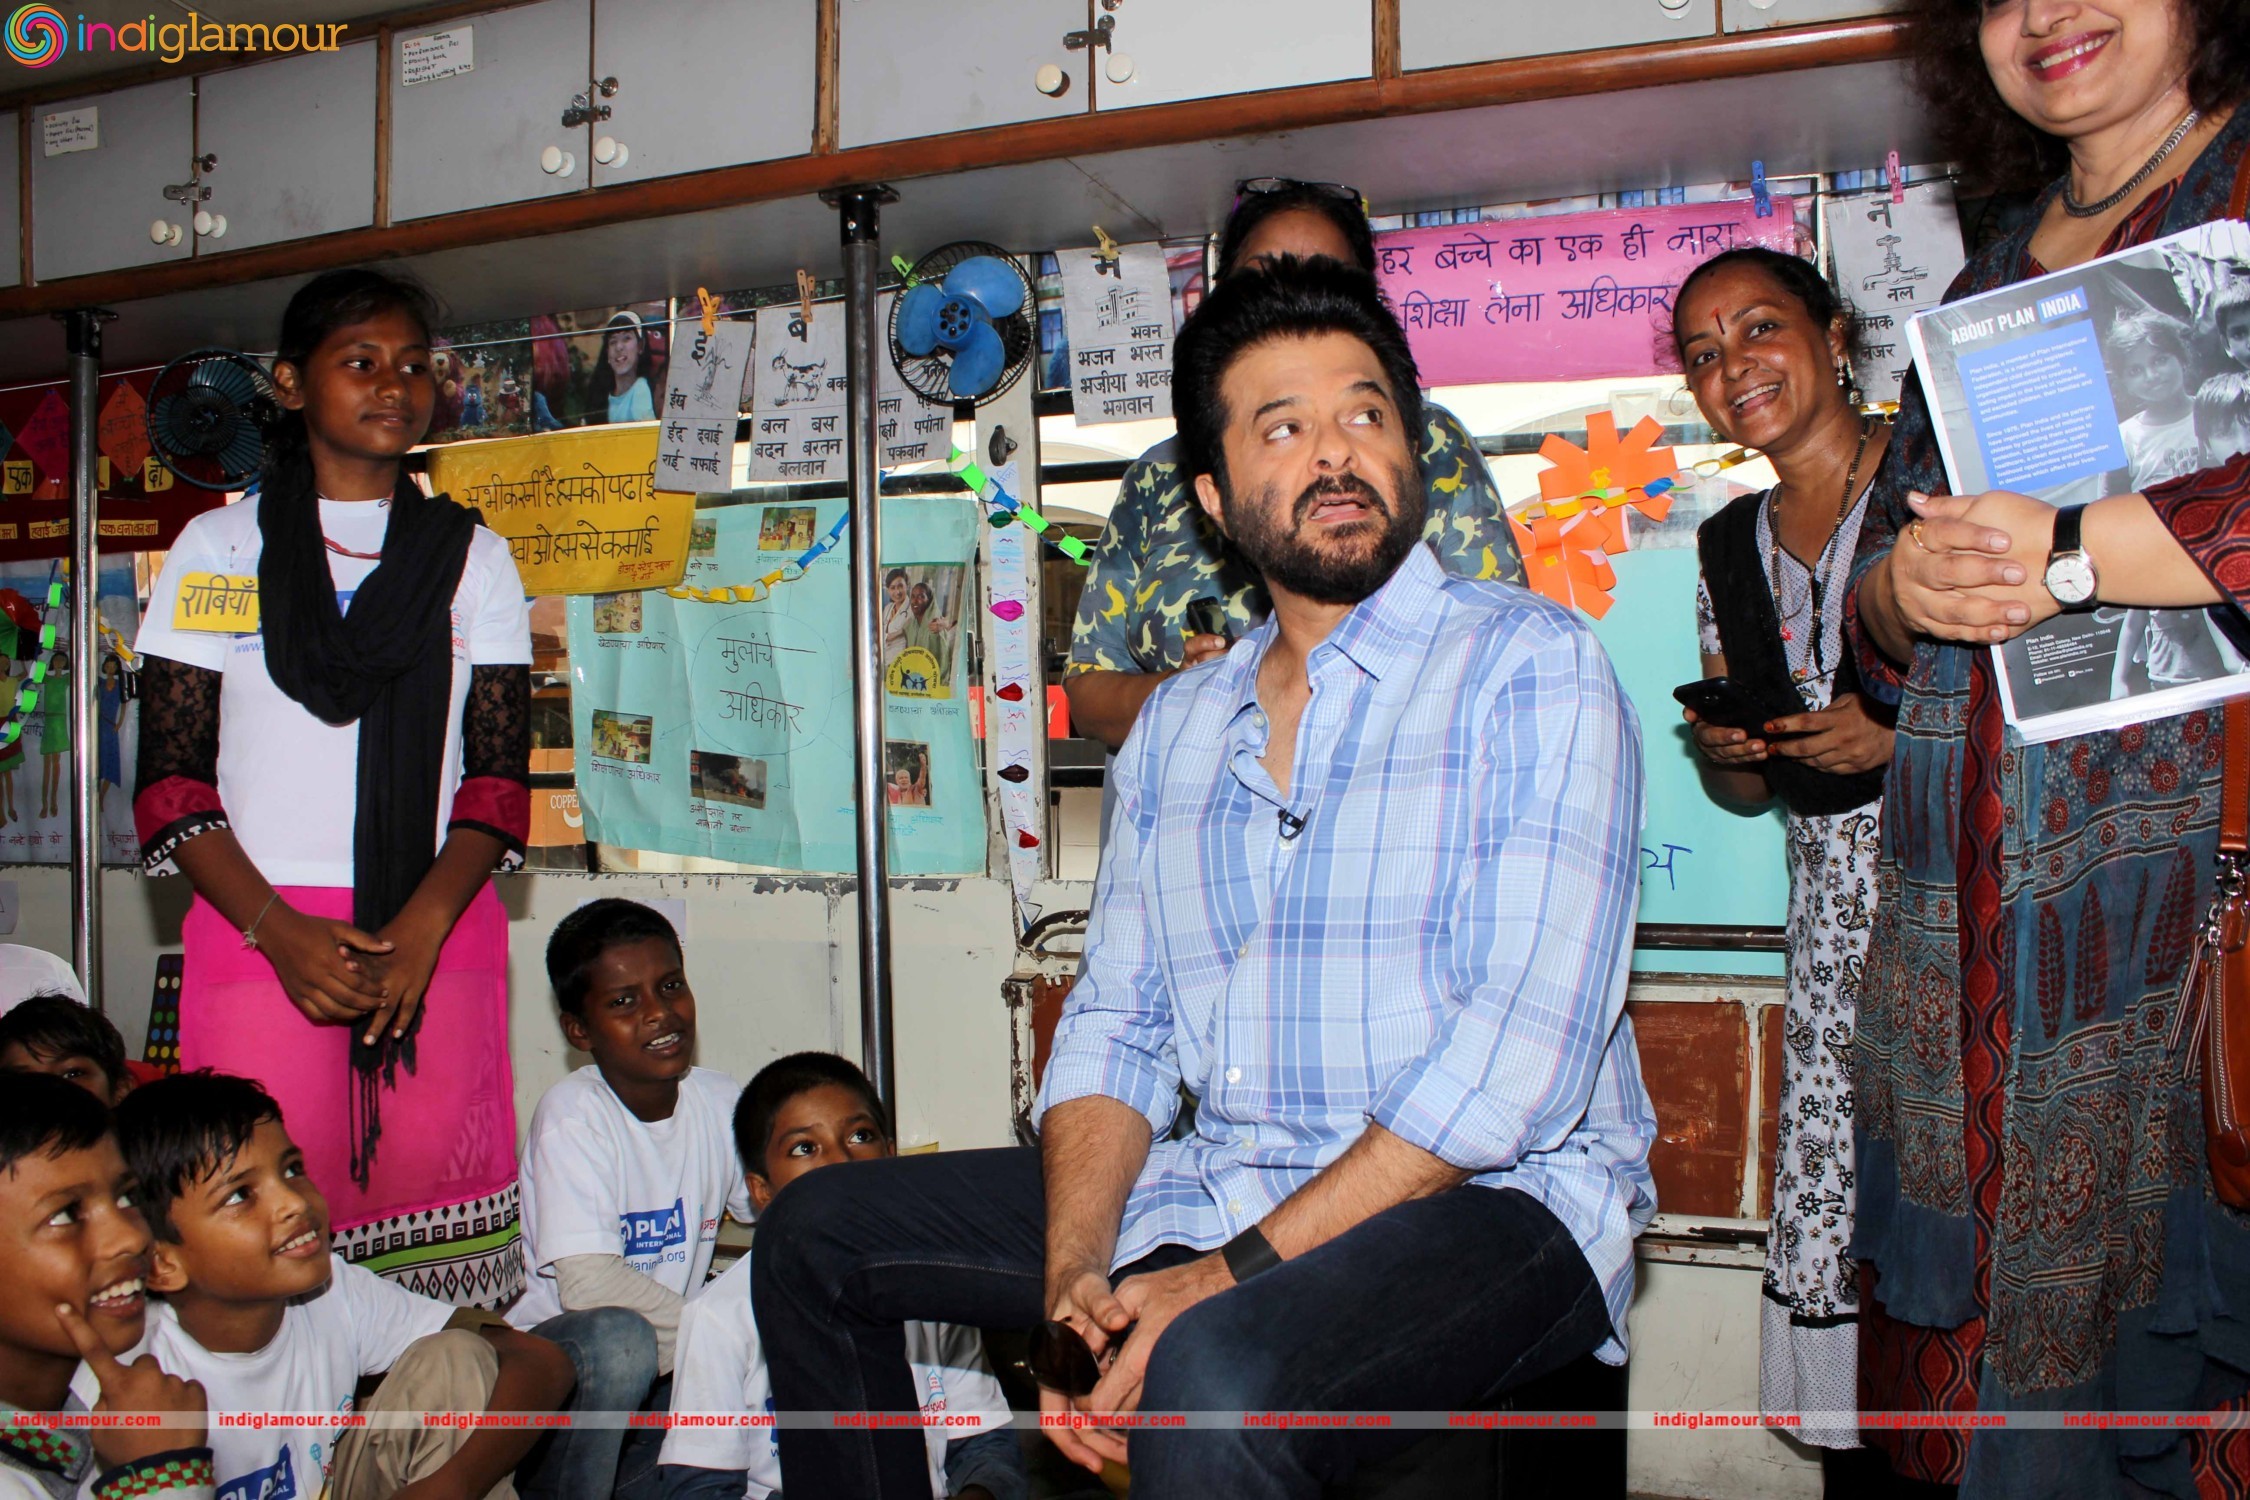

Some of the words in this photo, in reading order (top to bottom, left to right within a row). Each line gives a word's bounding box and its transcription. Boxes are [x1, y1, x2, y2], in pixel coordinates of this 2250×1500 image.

[1867, 199, 1893, 229] न
[1378, 246, 1414, 275] हर
[1435, 232, 1499, 269] बच्चे
[1508, 237, 1546, 266] का
[1555, 234, 1603, 261] एक
[1621, 223, 1654, 261] ही
[1667, 222, 1740, 255] नारा
[1400, 290, 1470, 333] शिक्षा
[1485, 281, 1544, 325] लेना
[1558, 275, 1678, 320] अधिकार
[1887, 285, 1915, 301] नल
[1951, 318, 1995, 346] ABOUT
[1997, 306, 2036, 332] PLAN
[2040, 293, 2082, 319] INDIA
[1131, 324, 1163, 339] भवन
[1078, 349, 1115, 366] भजन
[1131, 343, 1165, 361] भरत
[1080, 370, 1127, 394] भजीया
[670, 388, 687, 410] ईख
[1103, 395, 1154, 416] भगवान
[667, 421, 688, 442] ईद
[697, 423, 723, 445] दवाई
[761, 418, 789, 434] बल
[811, 415, 838, 433] बस
[914, 414, 945, 435] पपीता
[755, 442, 788, 459] बदन
[802, 438, 843, 457] बरतन
[887, 442, 928, 460] पकवान
[662, 449, 684, 471] राई
[690, 452, 721, 475] सफाई
[778, 460, 826, 476] बलवान
[182, 574, 259, 618] राबियाँ
[717, 632, 817, 673] मुलांचे
[719, 682, 805, 733] अधिकार
[627, 764, 661, 784] अधिकार
[550, 794, 580, 810] COPPE
